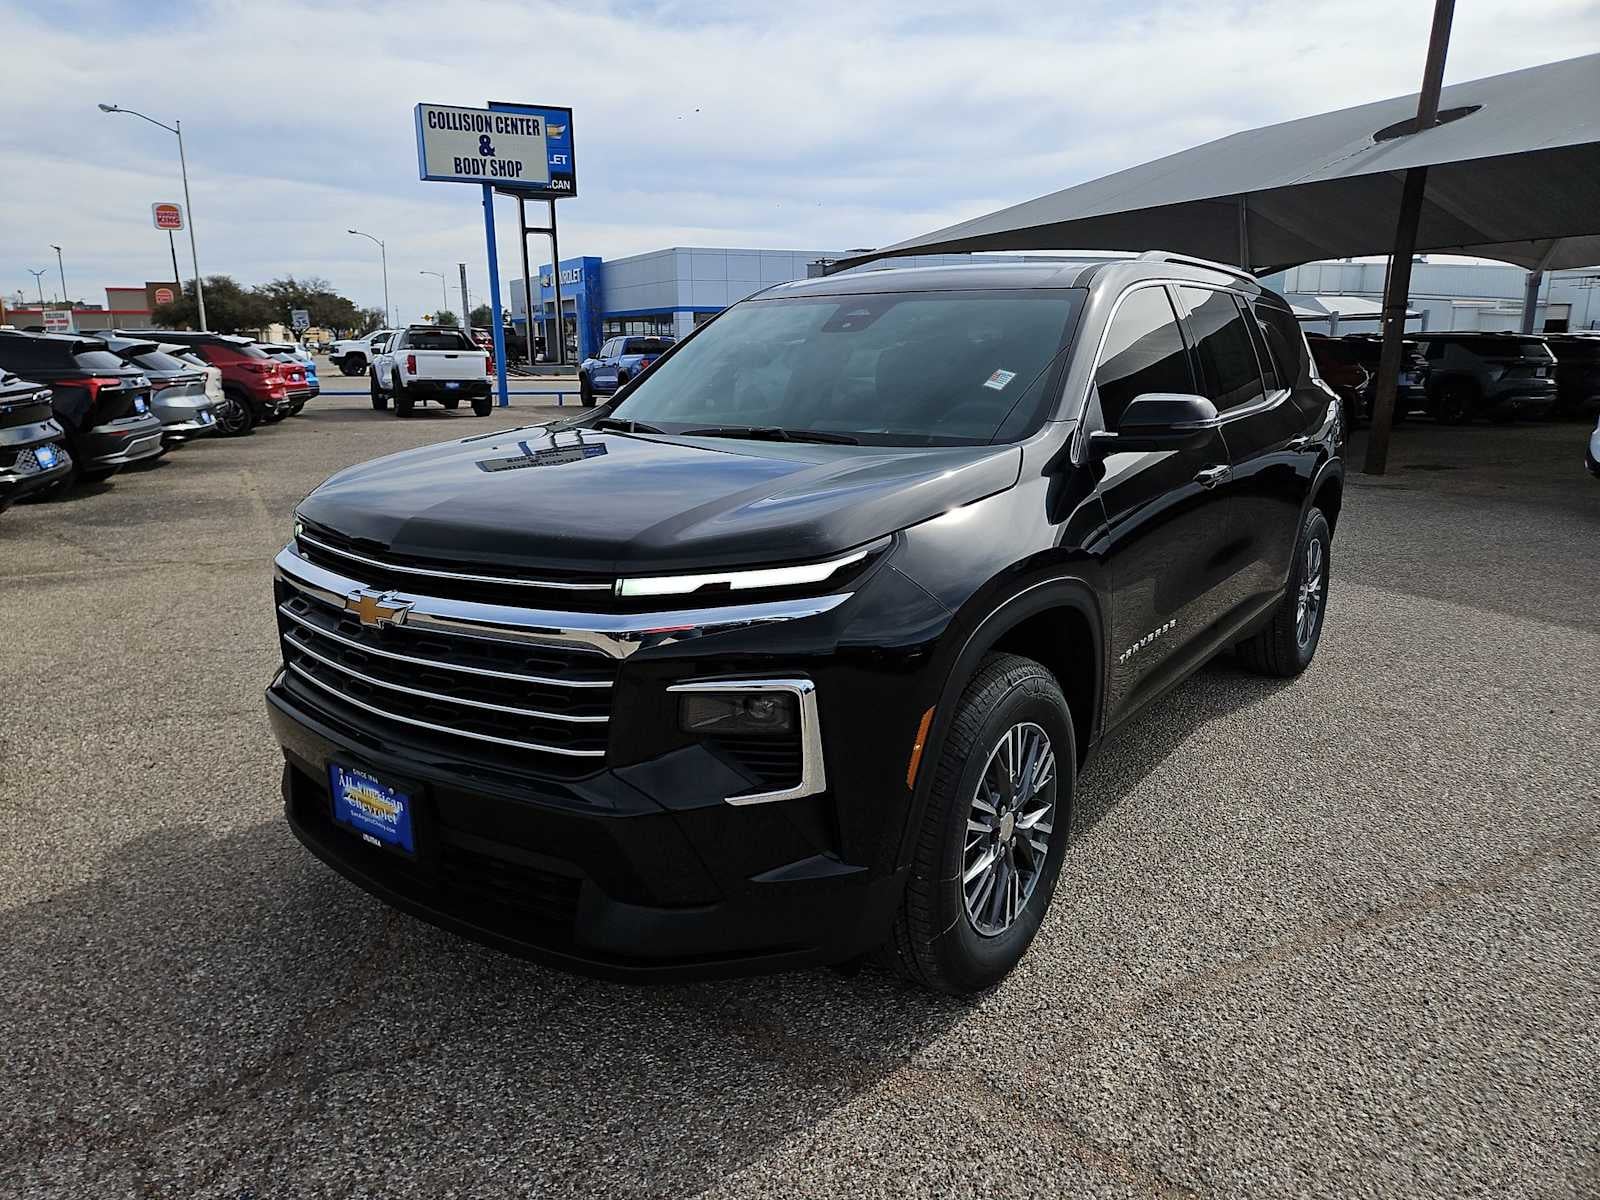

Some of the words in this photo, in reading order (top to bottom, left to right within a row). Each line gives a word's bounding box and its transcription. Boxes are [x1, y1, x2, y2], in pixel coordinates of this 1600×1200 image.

[428, 110, 493, 133] COLLISION
[495, 116, 540, 136] CENTER
[478, 134, 496, 157] &
[454, 157, 487, 176] BODY
[490, 159, 522, 178] SHOP
[157, 216, 181, 224] KING
[1120, 619, 1177, 665] TRAVERSE
